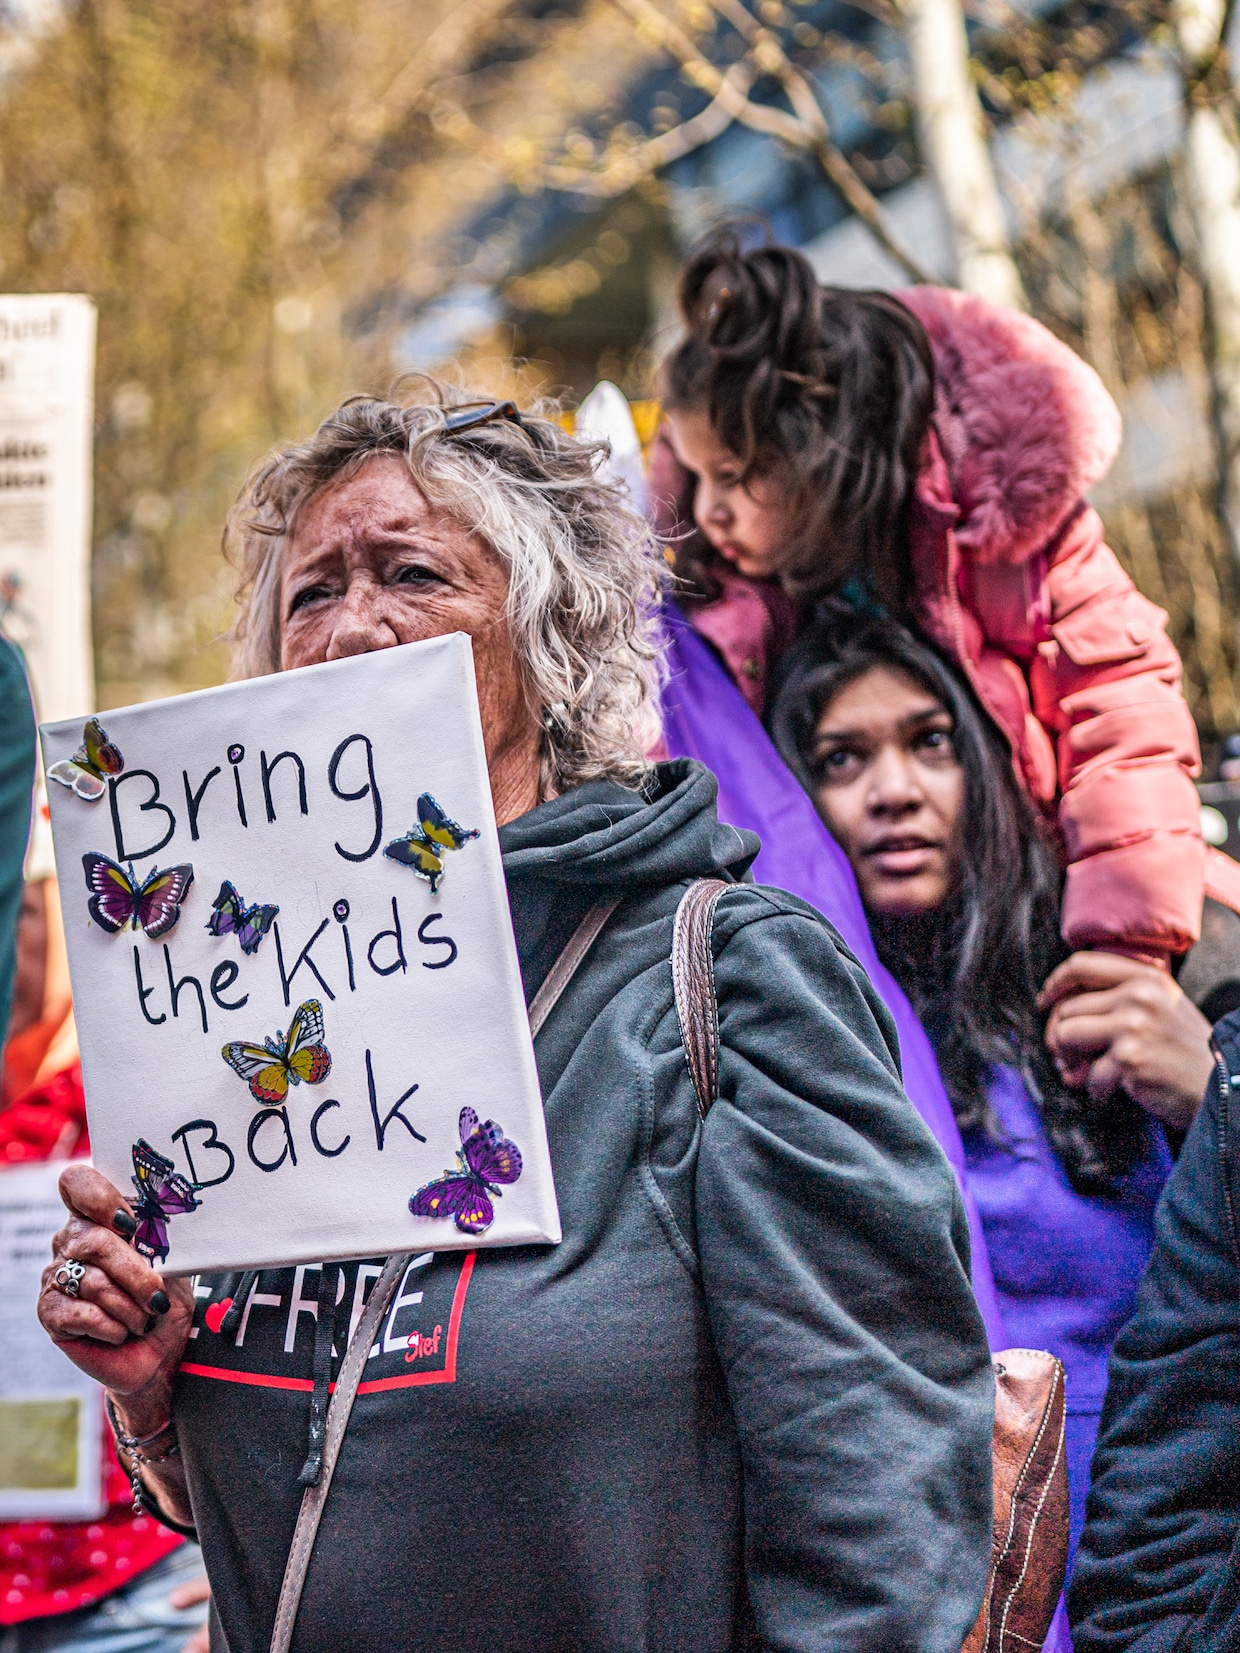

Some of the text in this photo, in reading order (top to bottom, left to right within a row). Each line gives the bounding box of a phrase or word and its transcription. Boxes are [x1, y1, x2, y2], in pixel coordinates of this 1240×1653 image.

[107, 733, 383, 863] Bring
[134, 896, 458, 1034] the Kids
[171, 1049, 427, 1188] Back
